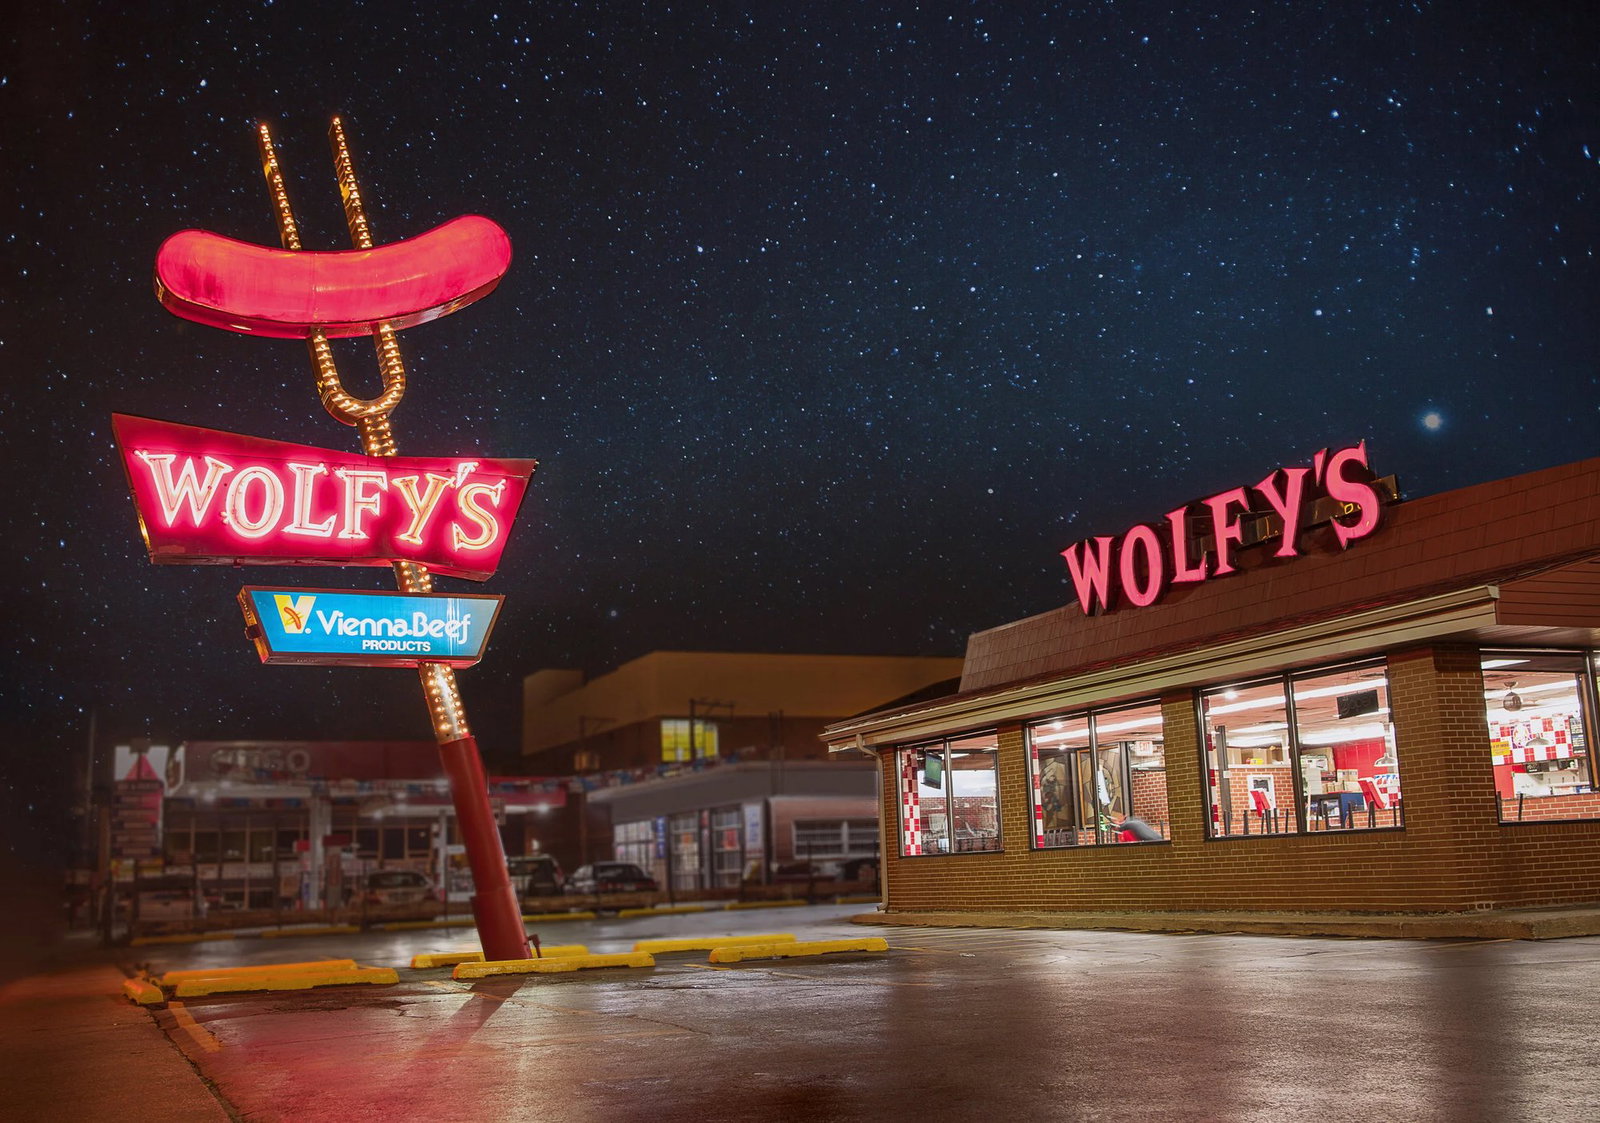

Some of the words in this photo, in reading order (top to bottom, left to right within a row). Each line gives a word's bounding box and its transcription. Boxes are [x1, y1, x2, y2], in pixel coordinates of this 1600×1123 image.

[134, 449, 506, 551] WOLFY'S
[1059, 438, 1381, 616] WOLFY'S
[362, 639, 431, 652] PRODUCTS
